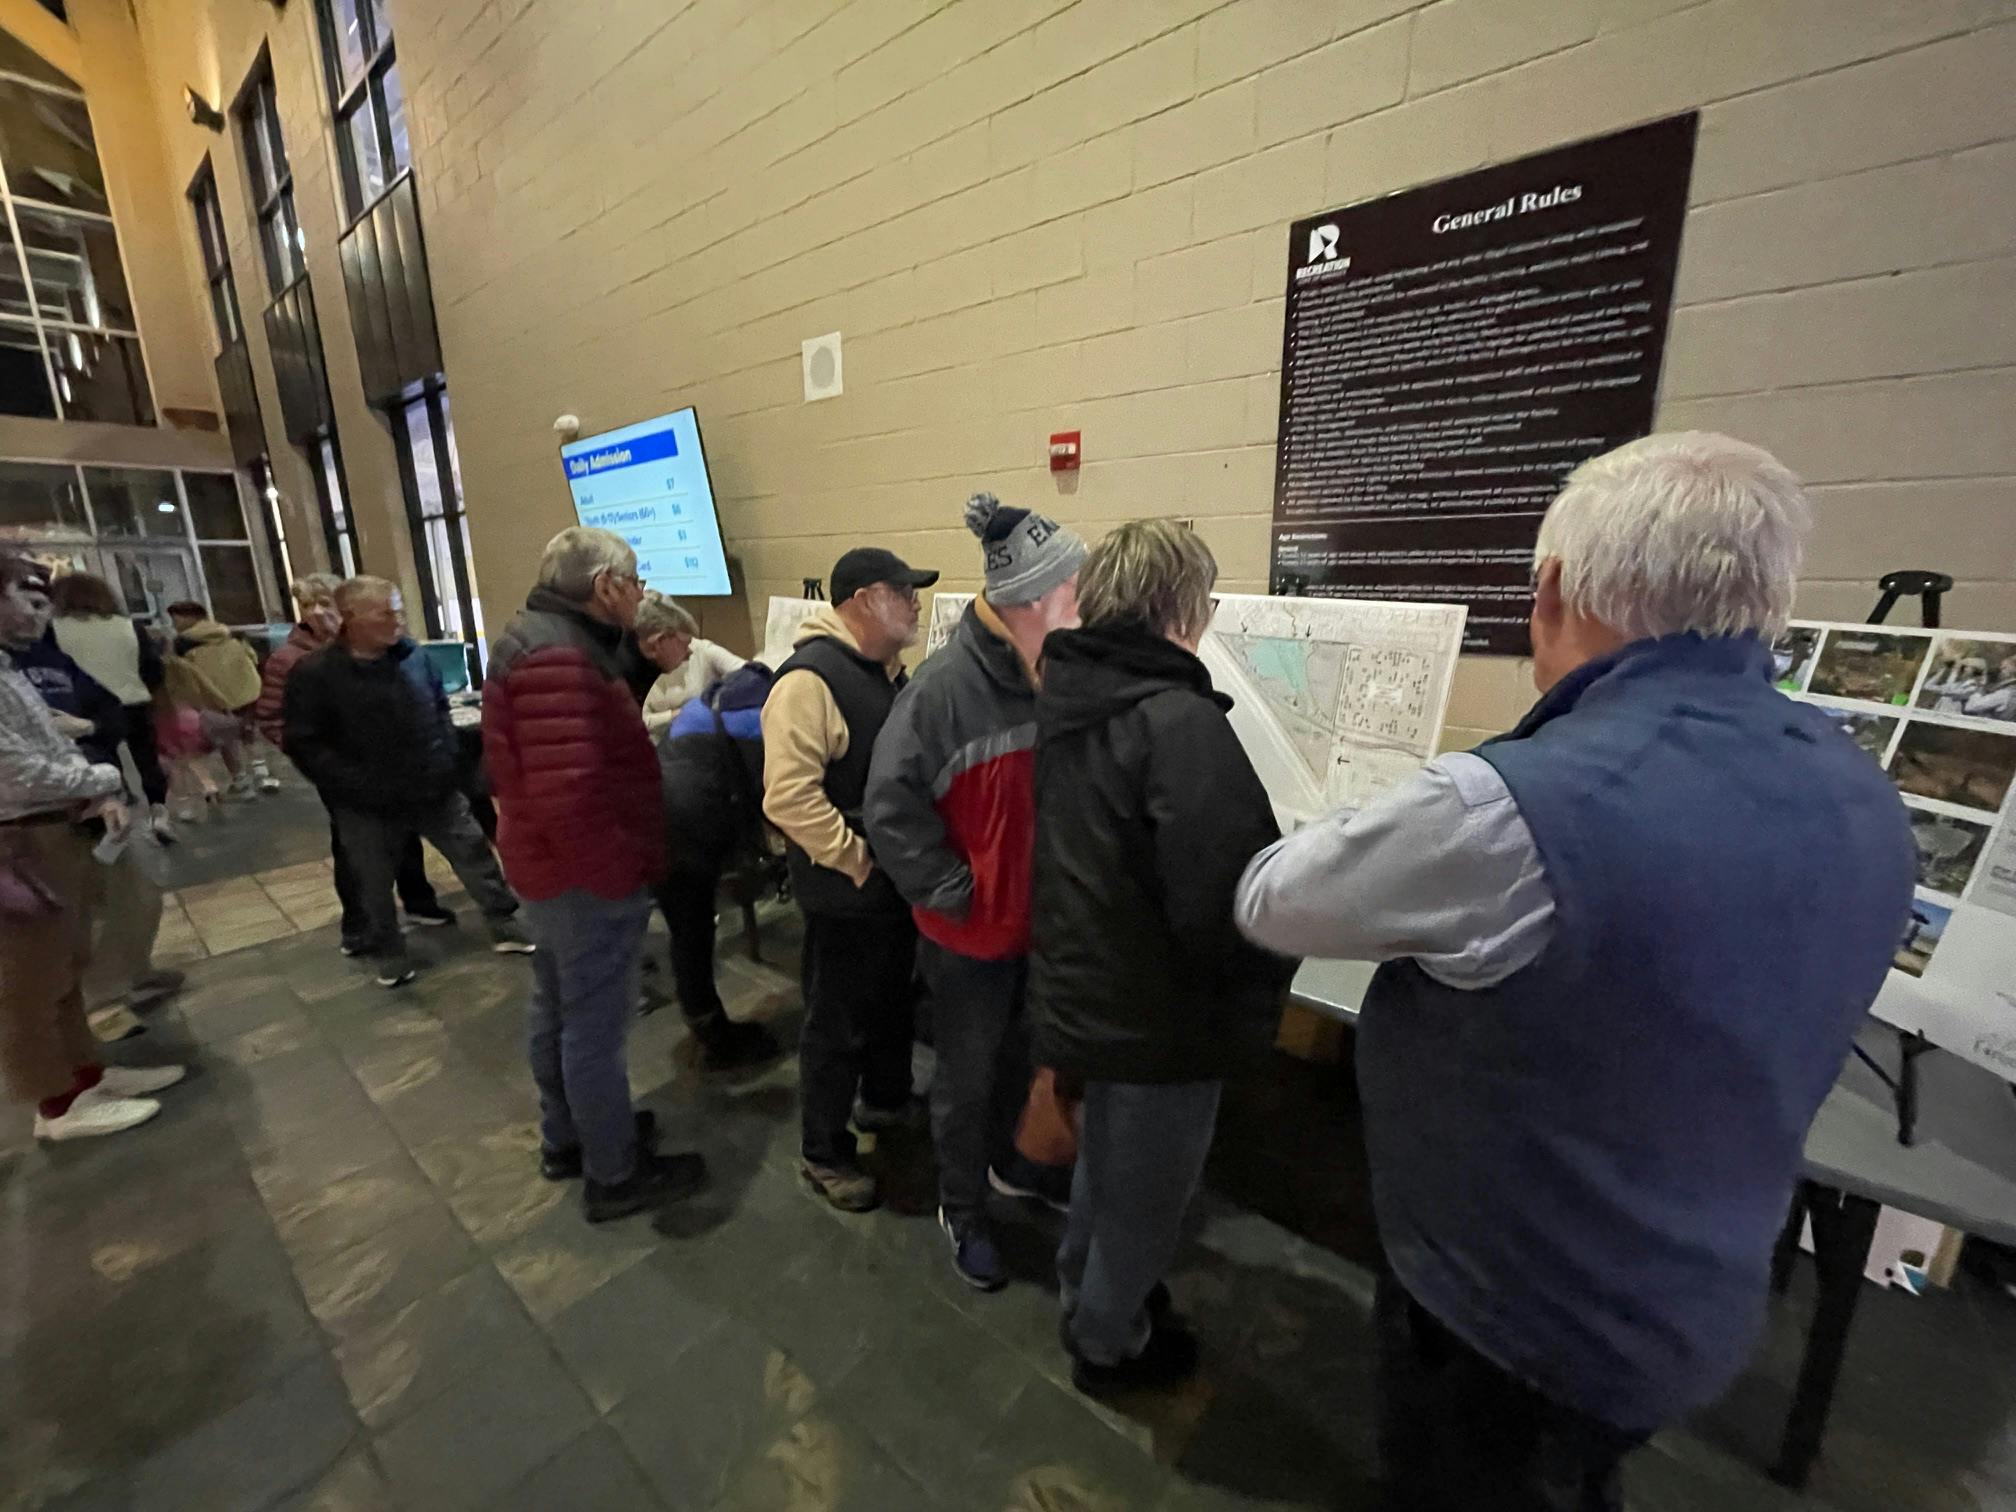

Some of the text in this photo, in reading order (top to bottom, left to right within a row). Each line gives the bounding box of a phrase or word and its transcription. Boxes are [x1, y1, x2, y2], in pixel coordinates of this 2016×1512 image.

[1432, 185, 1582, 234] General Rules
[590, 448, 632, 471] Admission
